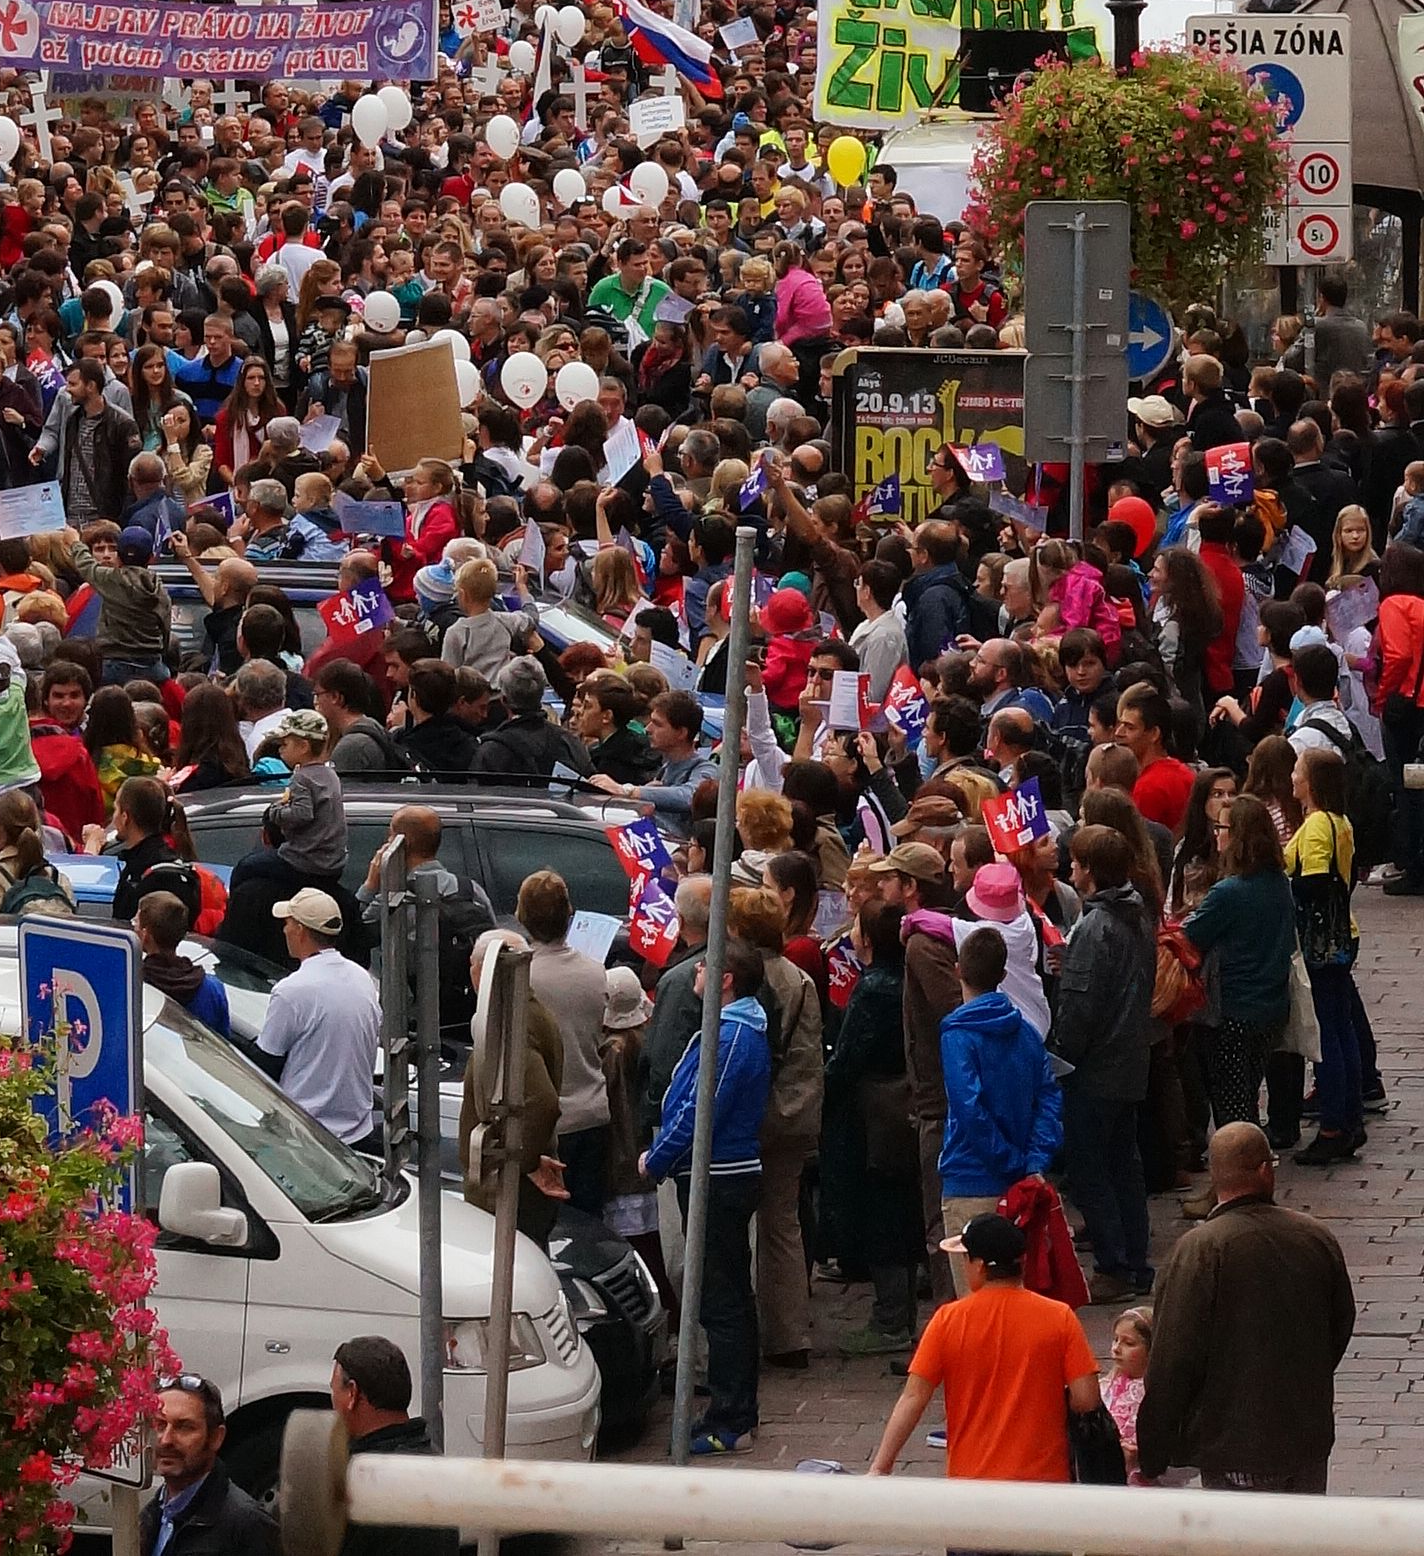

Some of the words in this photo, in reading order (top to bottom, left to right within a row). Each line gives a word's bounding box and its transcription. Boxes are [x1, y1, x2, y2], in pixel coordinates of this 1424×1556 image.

[48, 1, 155, 37] NAJPRV
[161, 3, 251, 40] PRÁVO
[256, 7, 293, 40] NA
[296, 4, 374, 38] ŽIVOT
[41, 37, 71, 63] až
[82, 39, 164, 70] potom
[178, 39, 272, 72] ostatné
[285, 41, 370, 76] práva!
[1193, 22, 1266, 56] PEŠIA
[1274, 22, 1344, 56] ZÓNA
[1308, 165, 1331, 185] 10
[855, 392, 937, 415] 20.9.13
[53, 967, 103, 1134] P
